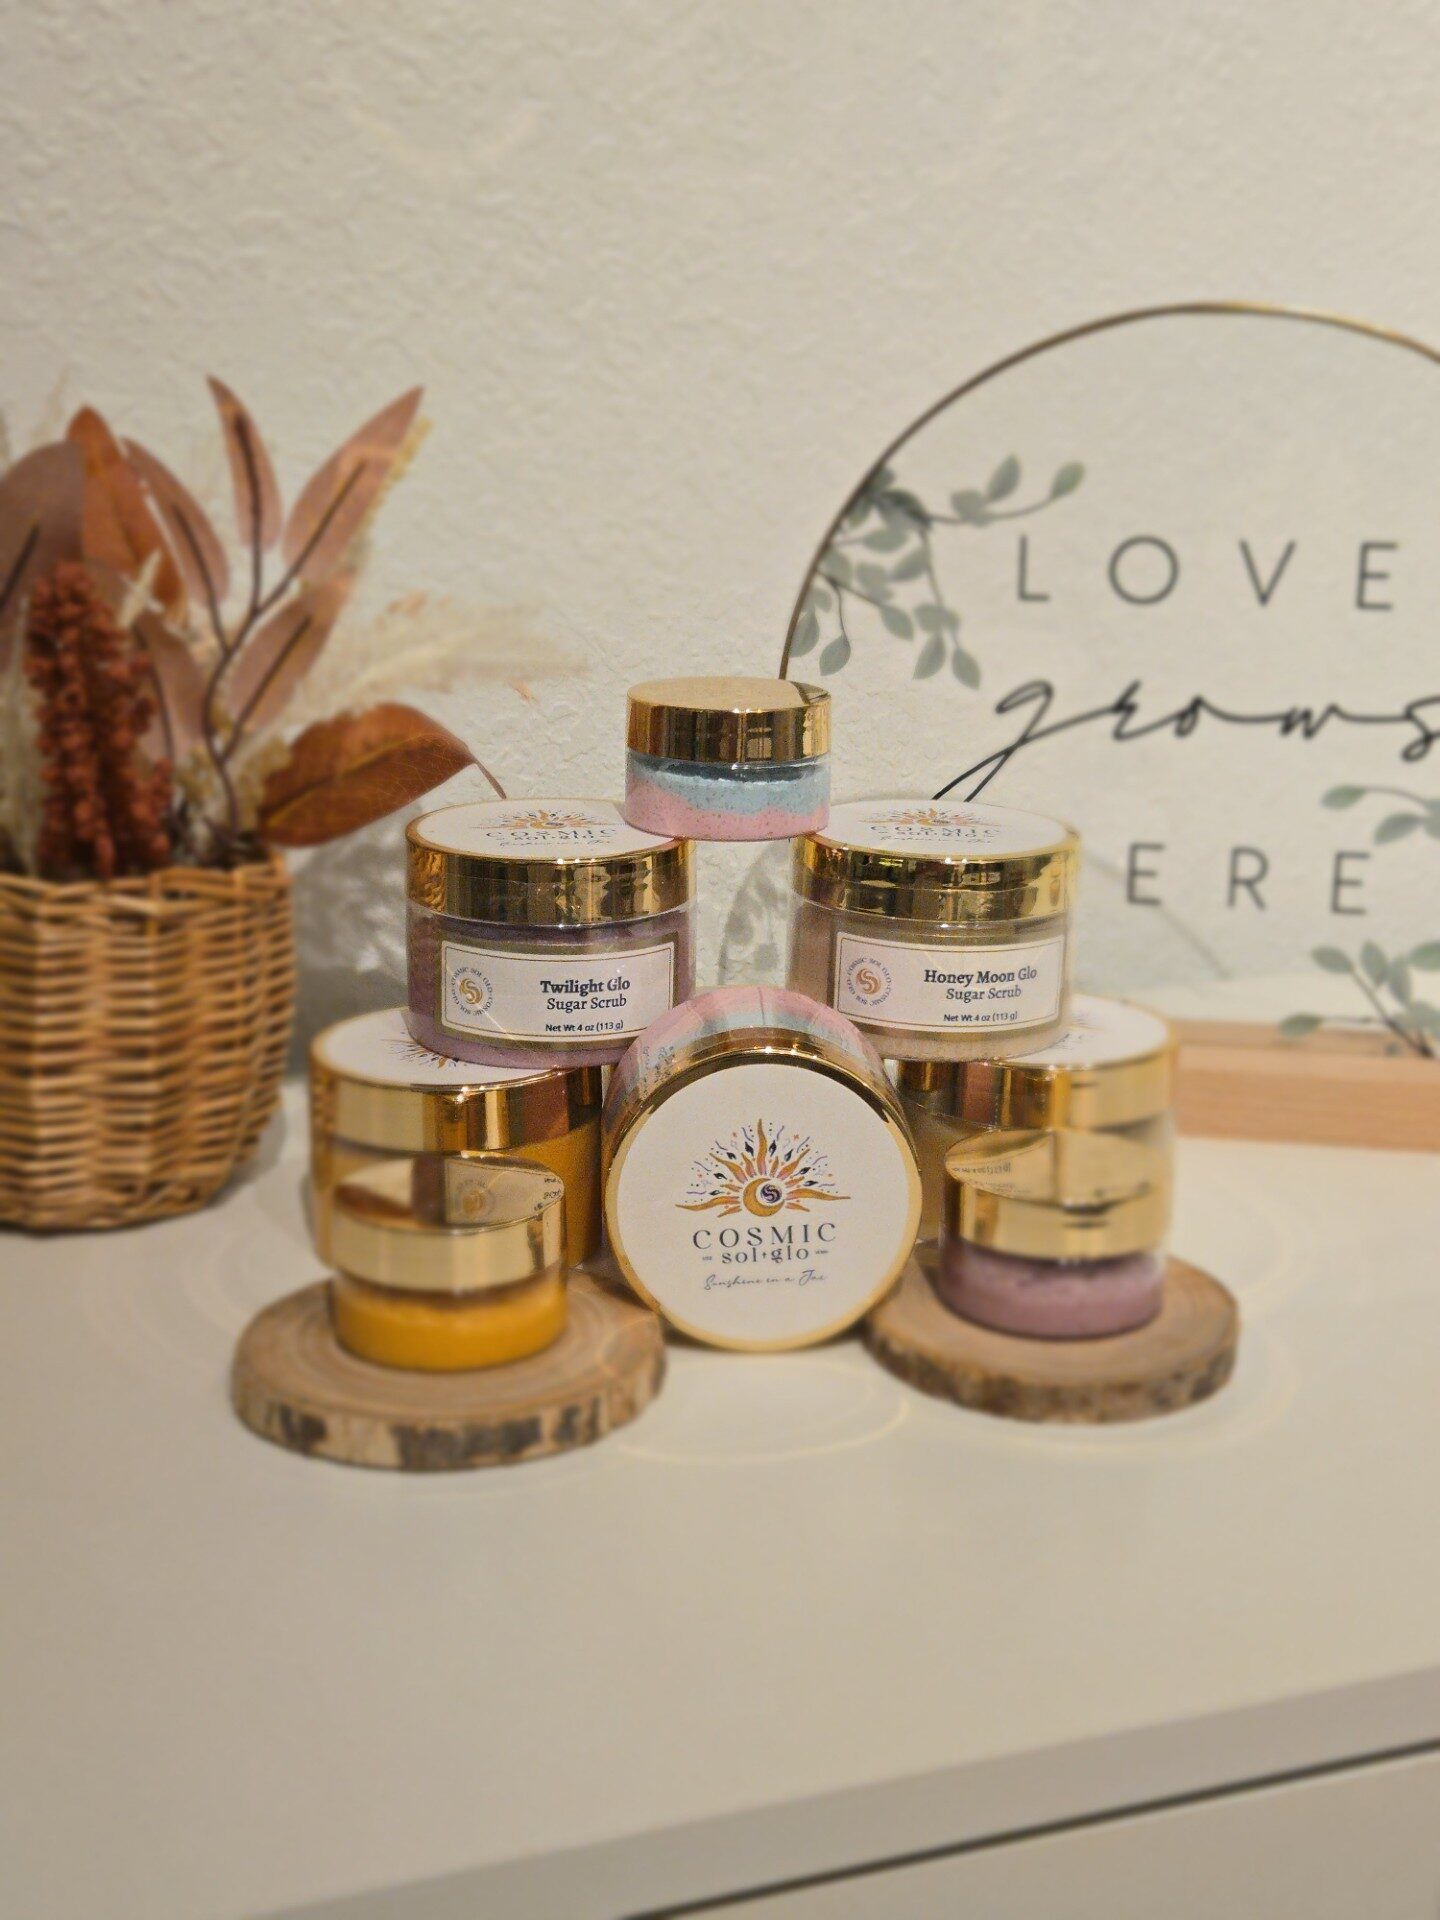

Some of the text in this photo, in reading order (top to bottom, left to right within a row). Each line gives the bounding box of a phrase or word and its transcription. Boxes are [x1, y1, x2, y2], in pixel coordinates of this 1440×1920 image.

[1017, 534, 1399, 611] LOVE
[932, 679, 1440, 803] grows
[1126, 841, 1371, 916] ERE
[540, 976, 631, 997] Twilight Glo
[924, 965, 1037, 987] Honey Moon Glo
[547, 993, 627, 1013] Sugar Scrub
[946, 984, 1022, 1004] Sugar Scrub
[545, 1019, 624, 1032] Net Wt 4 oz (113 g)
[944, 1013, 958, 1022] Net
[960, 1013, 973, 1022] Wt
[973, 1013, 980, 1022] 4
[980, 1014, 991, 1022] oz
[992, 1011, 1009, 1022] (113
[693, 1222, 836, 1250] COSMIC
